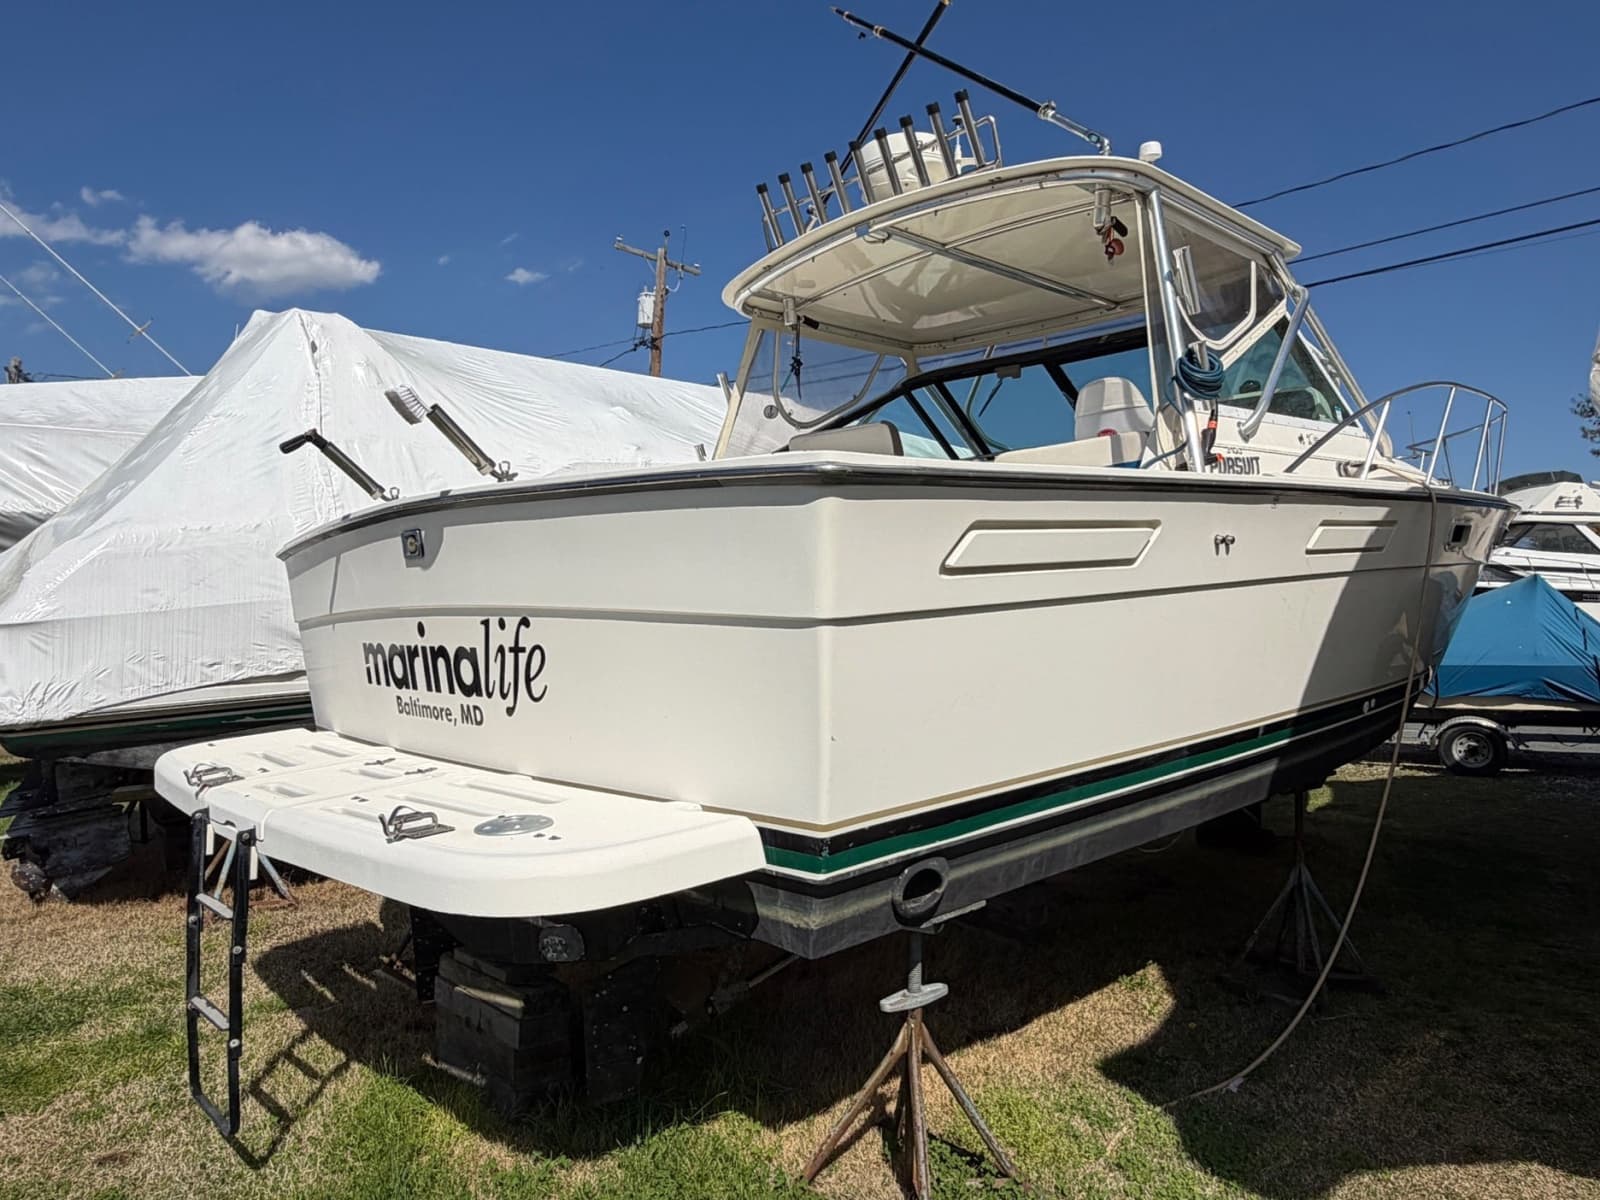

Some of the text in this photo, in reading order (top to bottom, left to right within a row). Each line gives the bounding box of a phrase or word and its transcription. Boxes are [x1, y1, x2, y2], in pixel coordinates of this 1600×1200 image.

[362, 616, 548, 717] marinalife
[396, 695, 485, 727] Baltimore, MD
